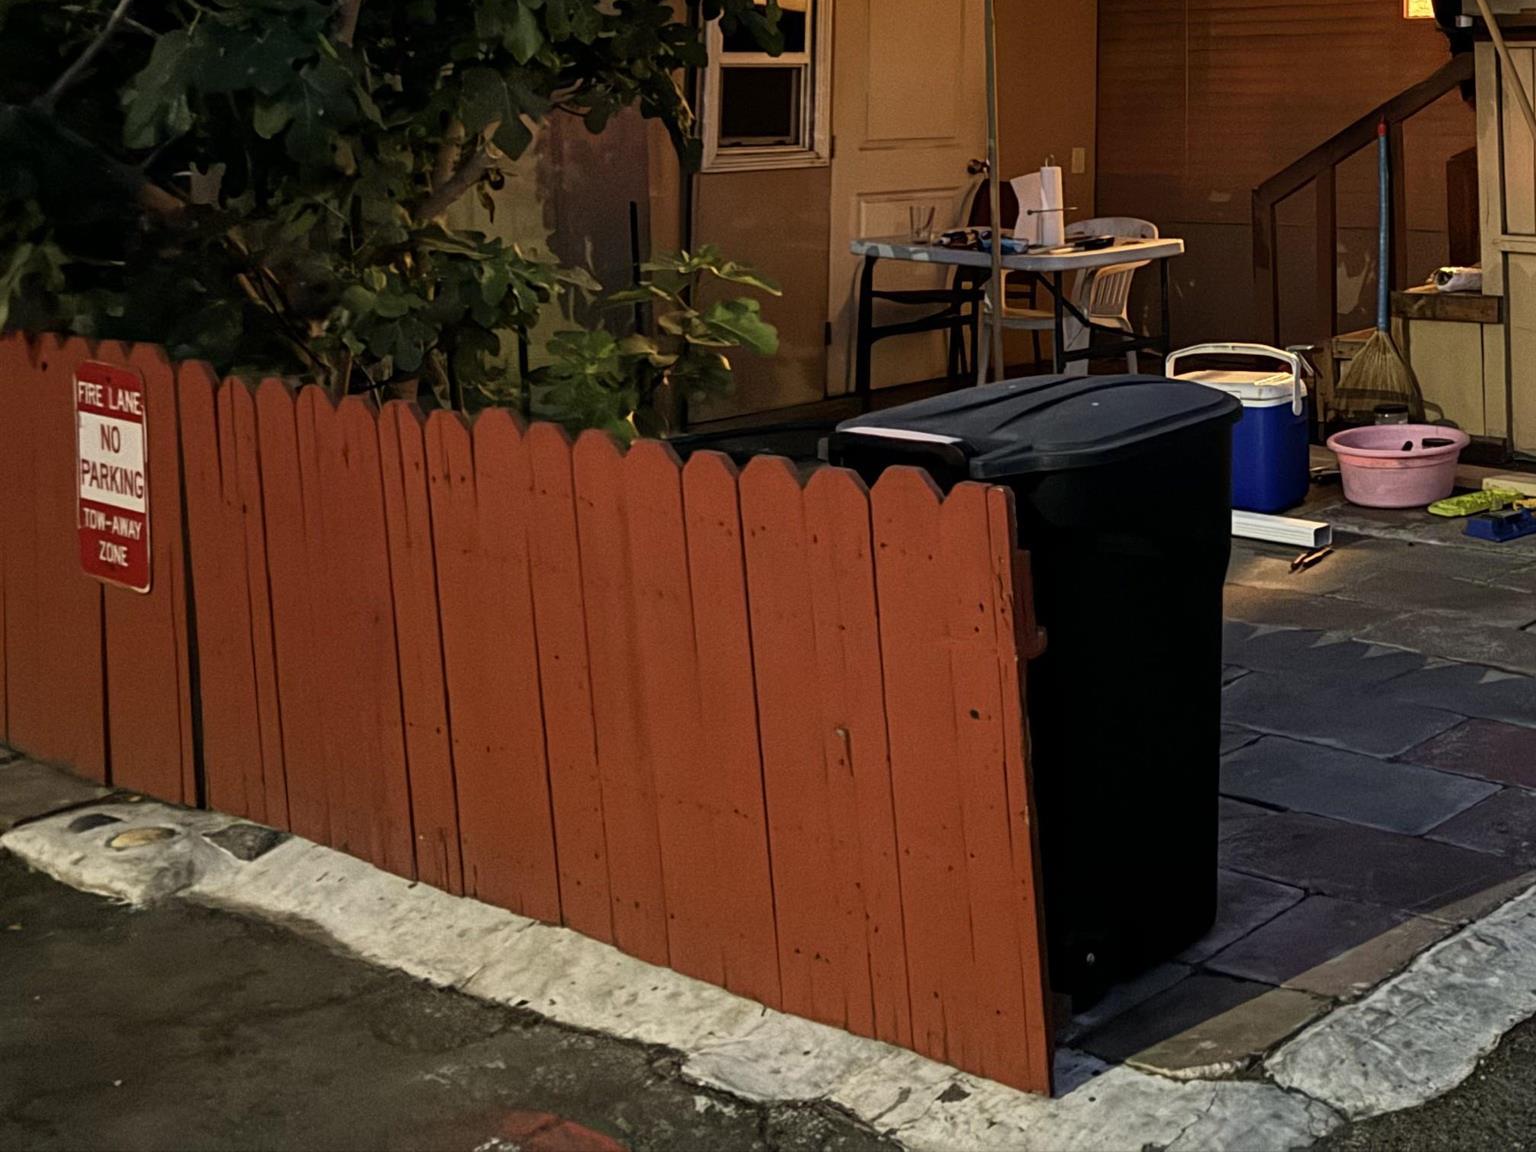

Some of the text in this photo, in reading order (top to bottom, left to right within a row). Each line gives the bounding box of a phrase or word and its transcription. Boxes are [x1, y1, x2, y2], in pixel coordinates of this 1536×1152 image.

[78, 381, 142, 415] FIRE LANE
[101, 423, 121, 453] NO
[81, 458, 144, 499] PARKING
[83, 507, 142, 540] TOW-AWAY
[99, 540, 128, 567] ZONE
